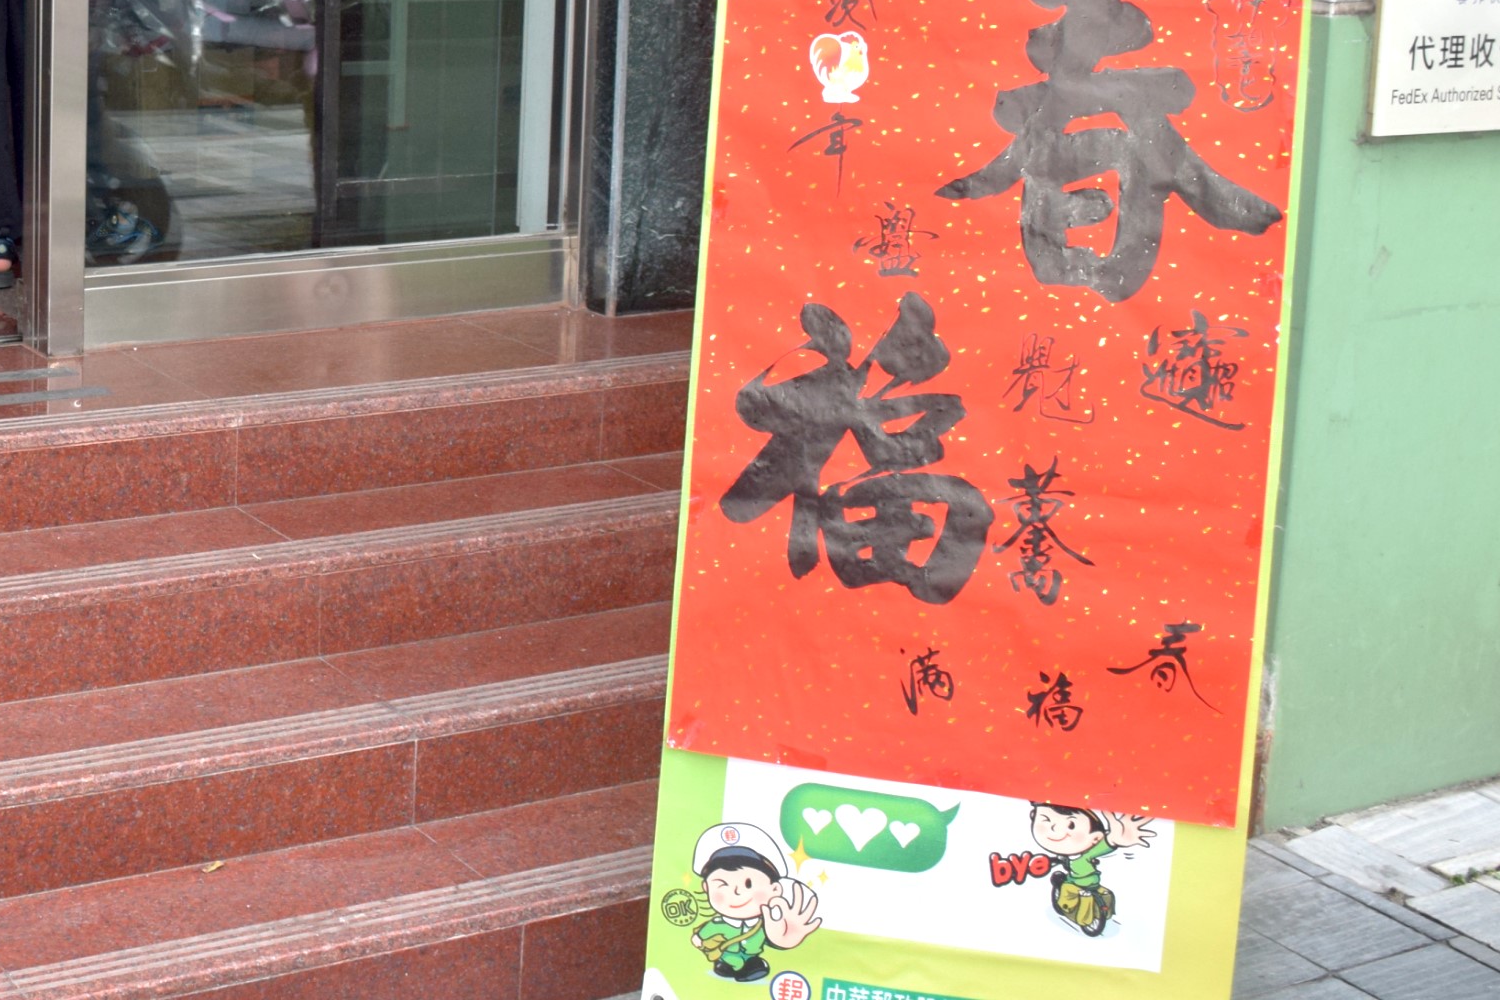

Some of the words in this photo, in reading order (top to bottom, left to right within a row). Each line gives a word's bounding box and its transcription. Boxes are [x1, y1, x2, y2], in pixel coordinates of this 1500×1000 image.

[1409, 34, 1496, 71] 代理收
[1390, 89, 1428, 105] FedEx
[1431, 86, 1493, 104] Authorized
[719, 291, 995, 606] 福
[989, 851, 1052, 888] bye
[665, 899, 697, 919] OK
